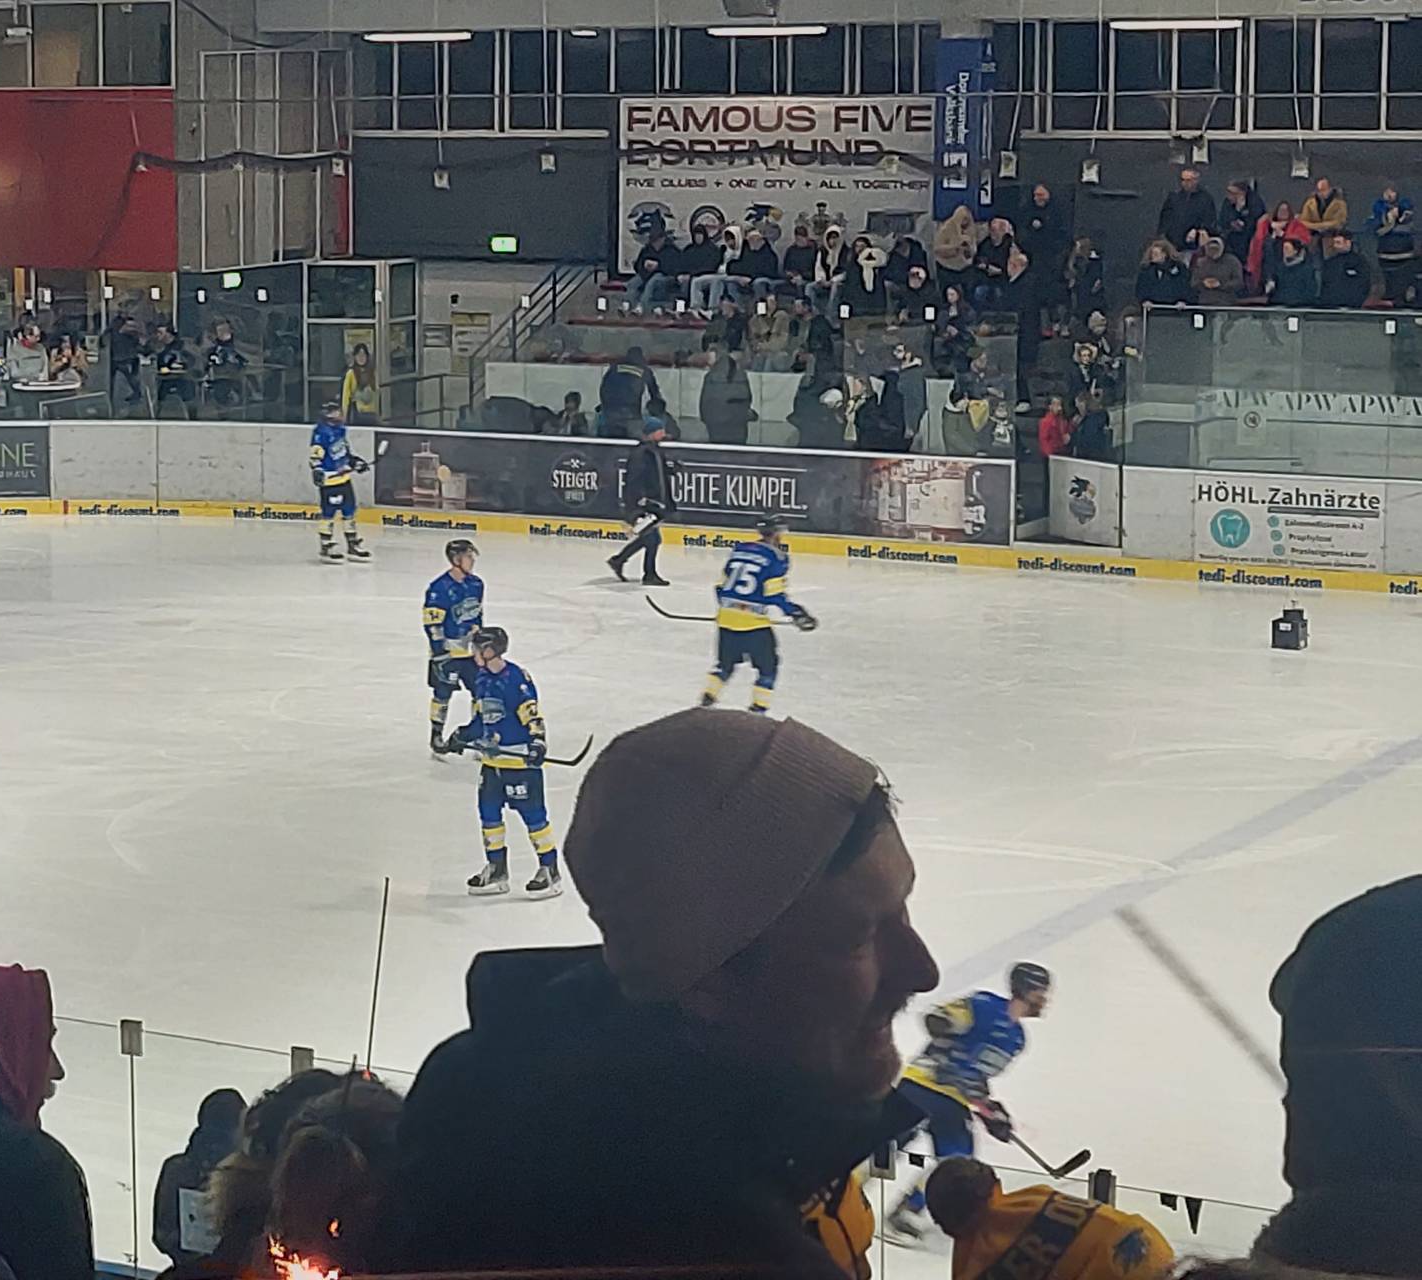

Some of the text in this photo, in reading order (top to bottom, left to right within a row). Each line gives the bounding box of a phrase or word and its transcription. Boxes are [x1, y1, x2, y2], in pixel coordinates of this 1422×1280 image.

[627, 105, 932, 133] FAMOUS FIVE
[626, 178, 655, 188] FIVE
[661, 178, 707, 188] CLUBS
[729, 178, 756, 188] ONE
[763, 178, 796, 188] CITY
[819, 179, 846, 189] ALL
[853, 179, 928, 190] TOGETHER
[552, 470, 598, 490] STEIGER
[726, 474, 808, 510] KUMPEL.
[847, 545, 958, 564] tedi-discount.com
[1017, 557, 1137, 577] tedi-discount.com
[1198, 568, 1323, 589] tedi-discount.com
